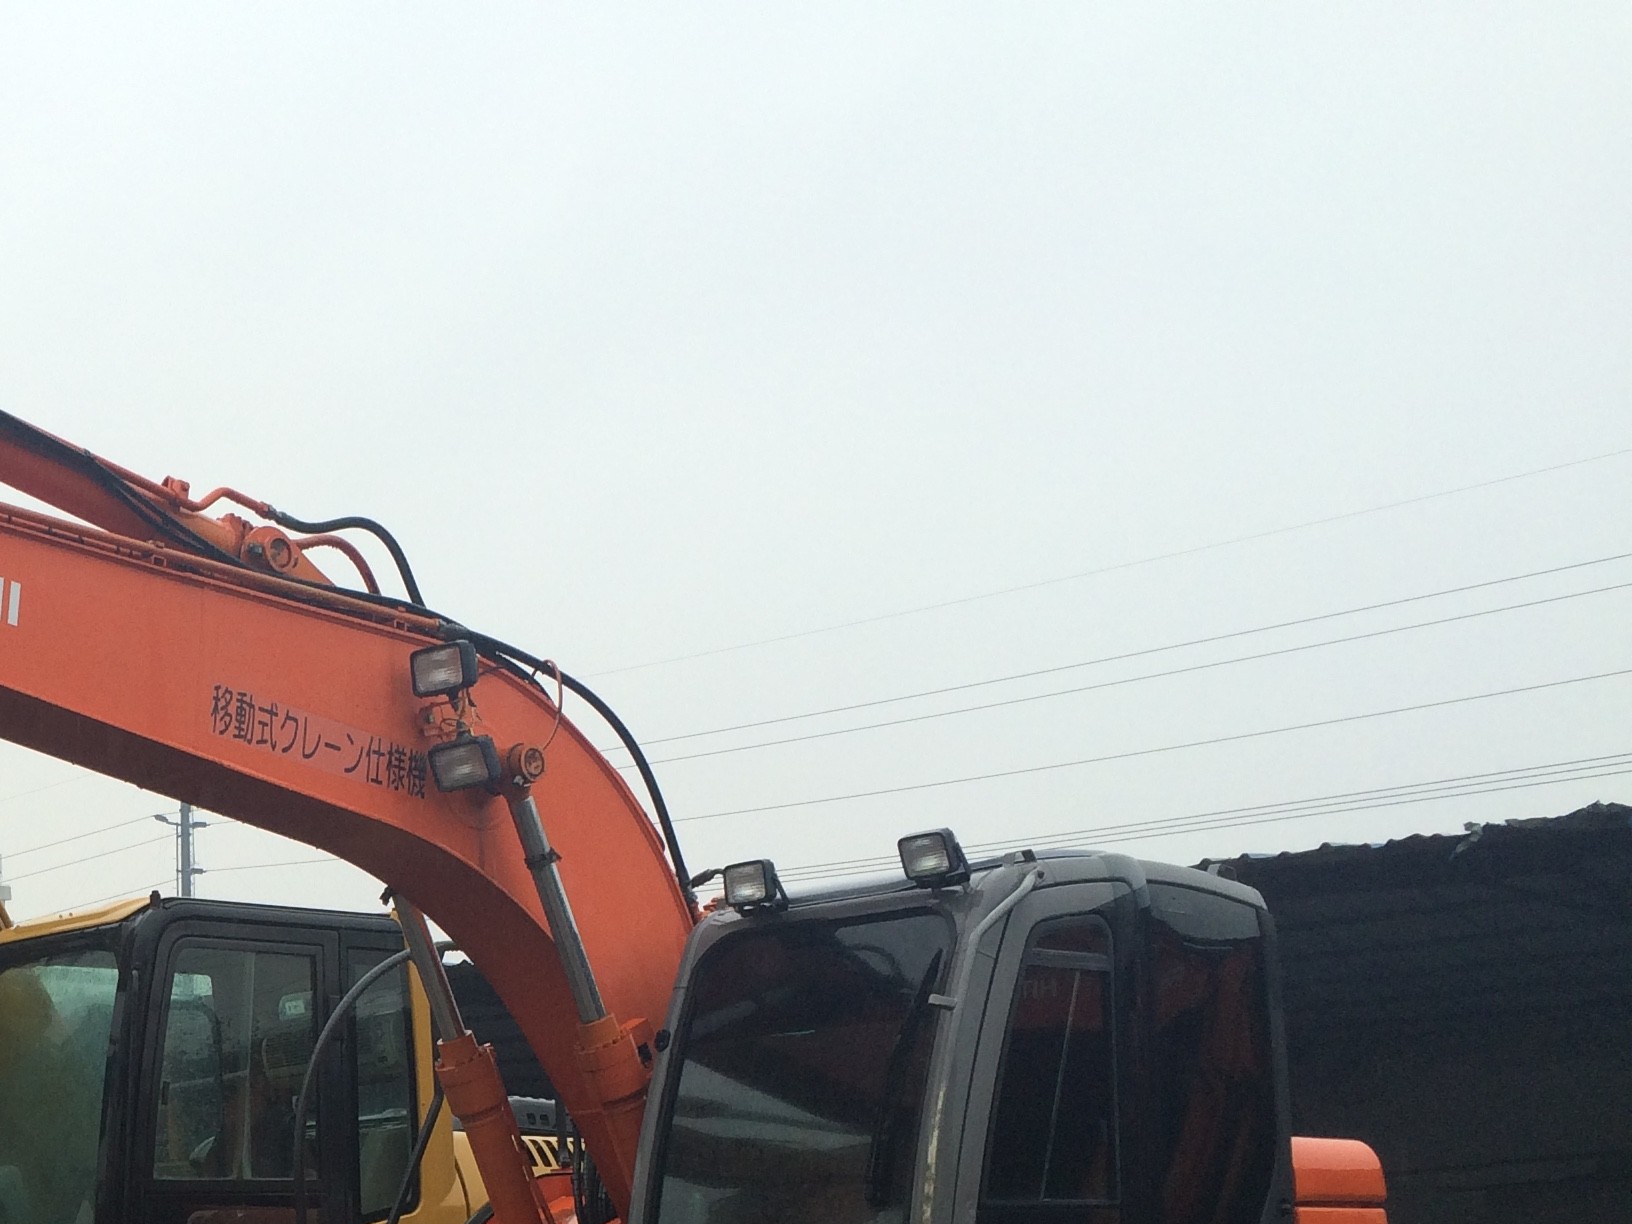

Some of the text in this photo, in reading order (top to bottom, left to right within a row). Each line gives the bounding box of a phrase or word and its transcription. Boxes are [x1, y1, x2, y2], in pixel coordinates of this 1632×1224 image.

[210, 684, 428, 799] 移動式クレーン仕様機
